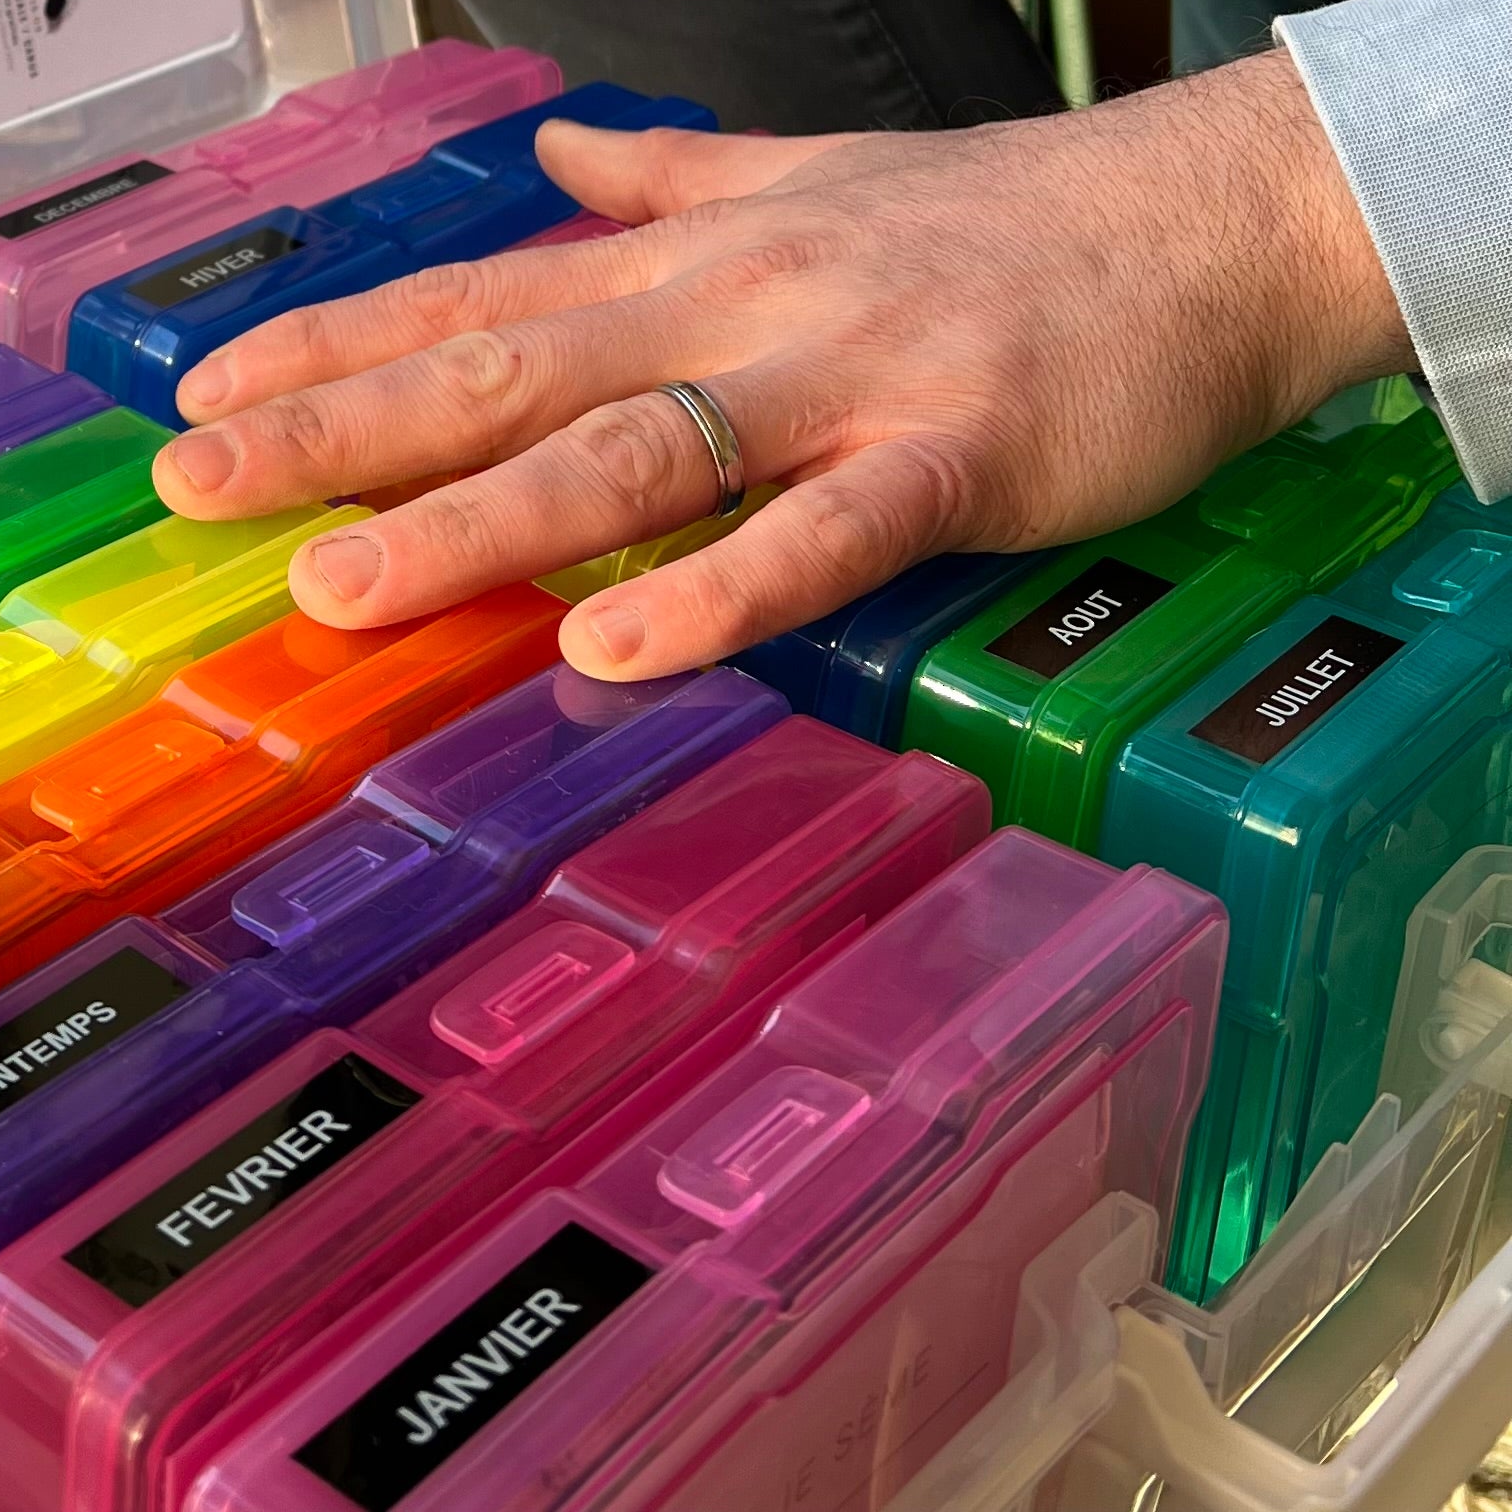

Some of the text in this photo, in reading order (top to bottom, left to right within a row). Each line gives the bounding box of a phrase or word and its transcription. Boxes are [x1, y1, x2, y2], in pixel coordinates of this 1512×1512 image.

[32, 176, 138, 226] DECEMBRE
[179, 246, 266, 290] HIVER
[1048, 588, 1124, 648] AOUT
[1255, 648, 1355, 729] JUILLET
[156, 1108, 351, 1249] FEVRIER
[398, 1286, 582, 1445] JANVIER
